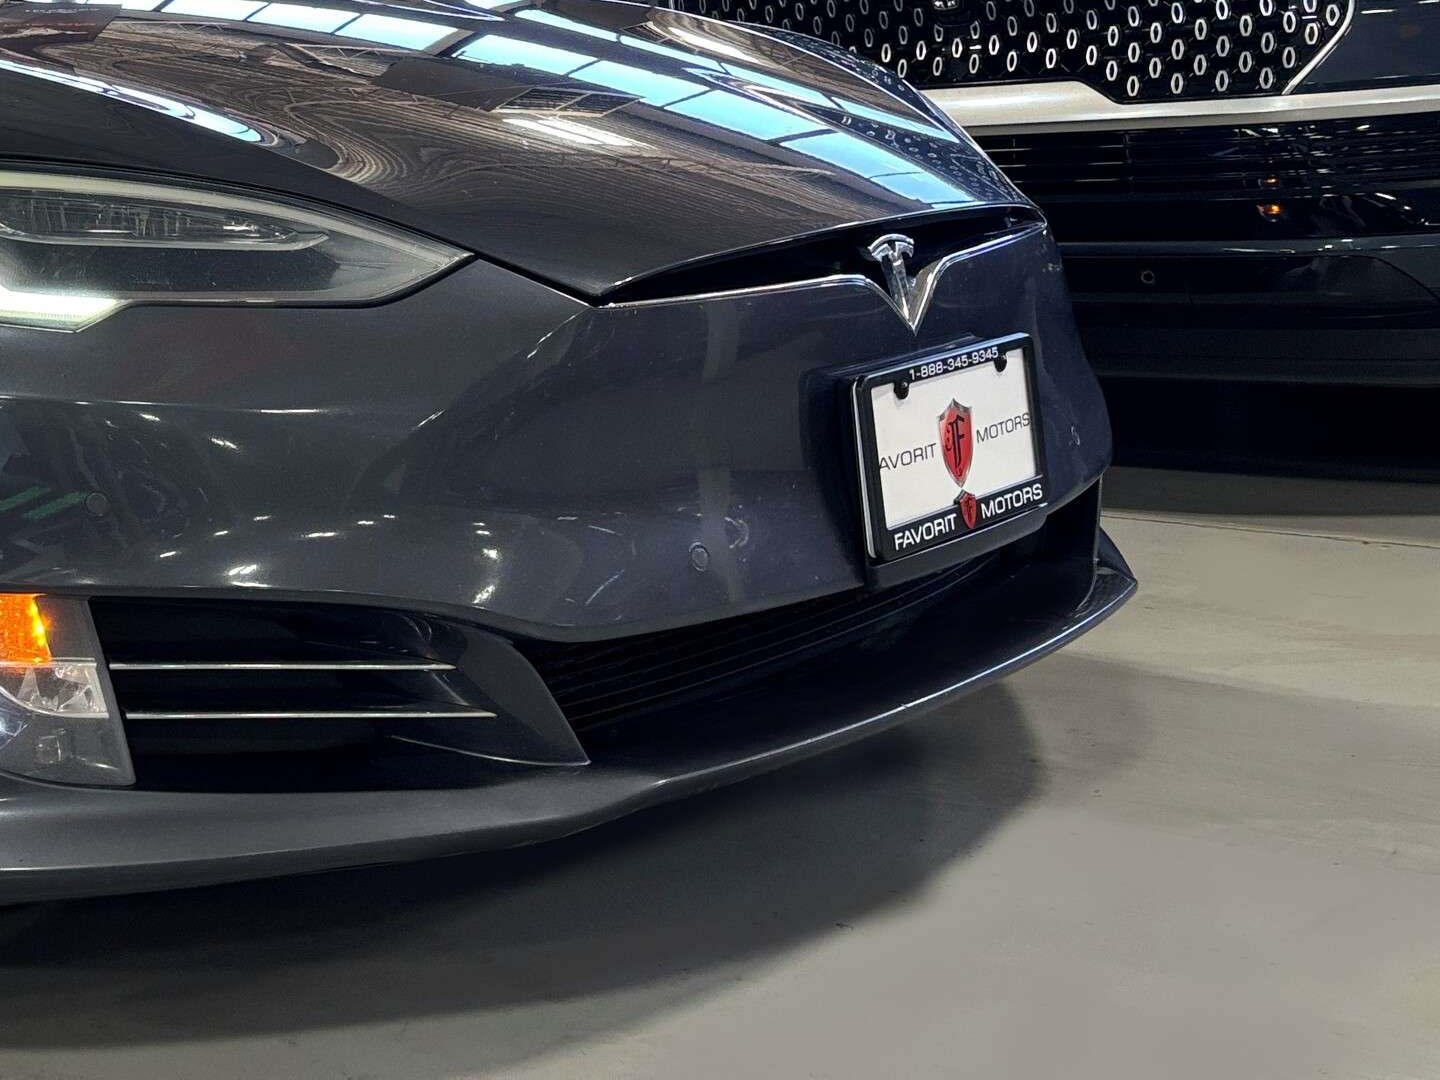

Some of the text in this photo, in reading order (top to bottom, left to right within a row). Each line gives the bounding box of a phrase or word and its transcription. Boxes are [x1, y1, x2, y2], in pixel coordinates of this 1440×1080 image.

[908, 346, 1000, 381] 1-888-345-9345
[878, 442, 937, 471] AVORIT
[975, 411, 1032, 445] MOTORS
[893, 513, 958, 551] FAVORIT
[980, 483, 1044, 520] MOTORS
